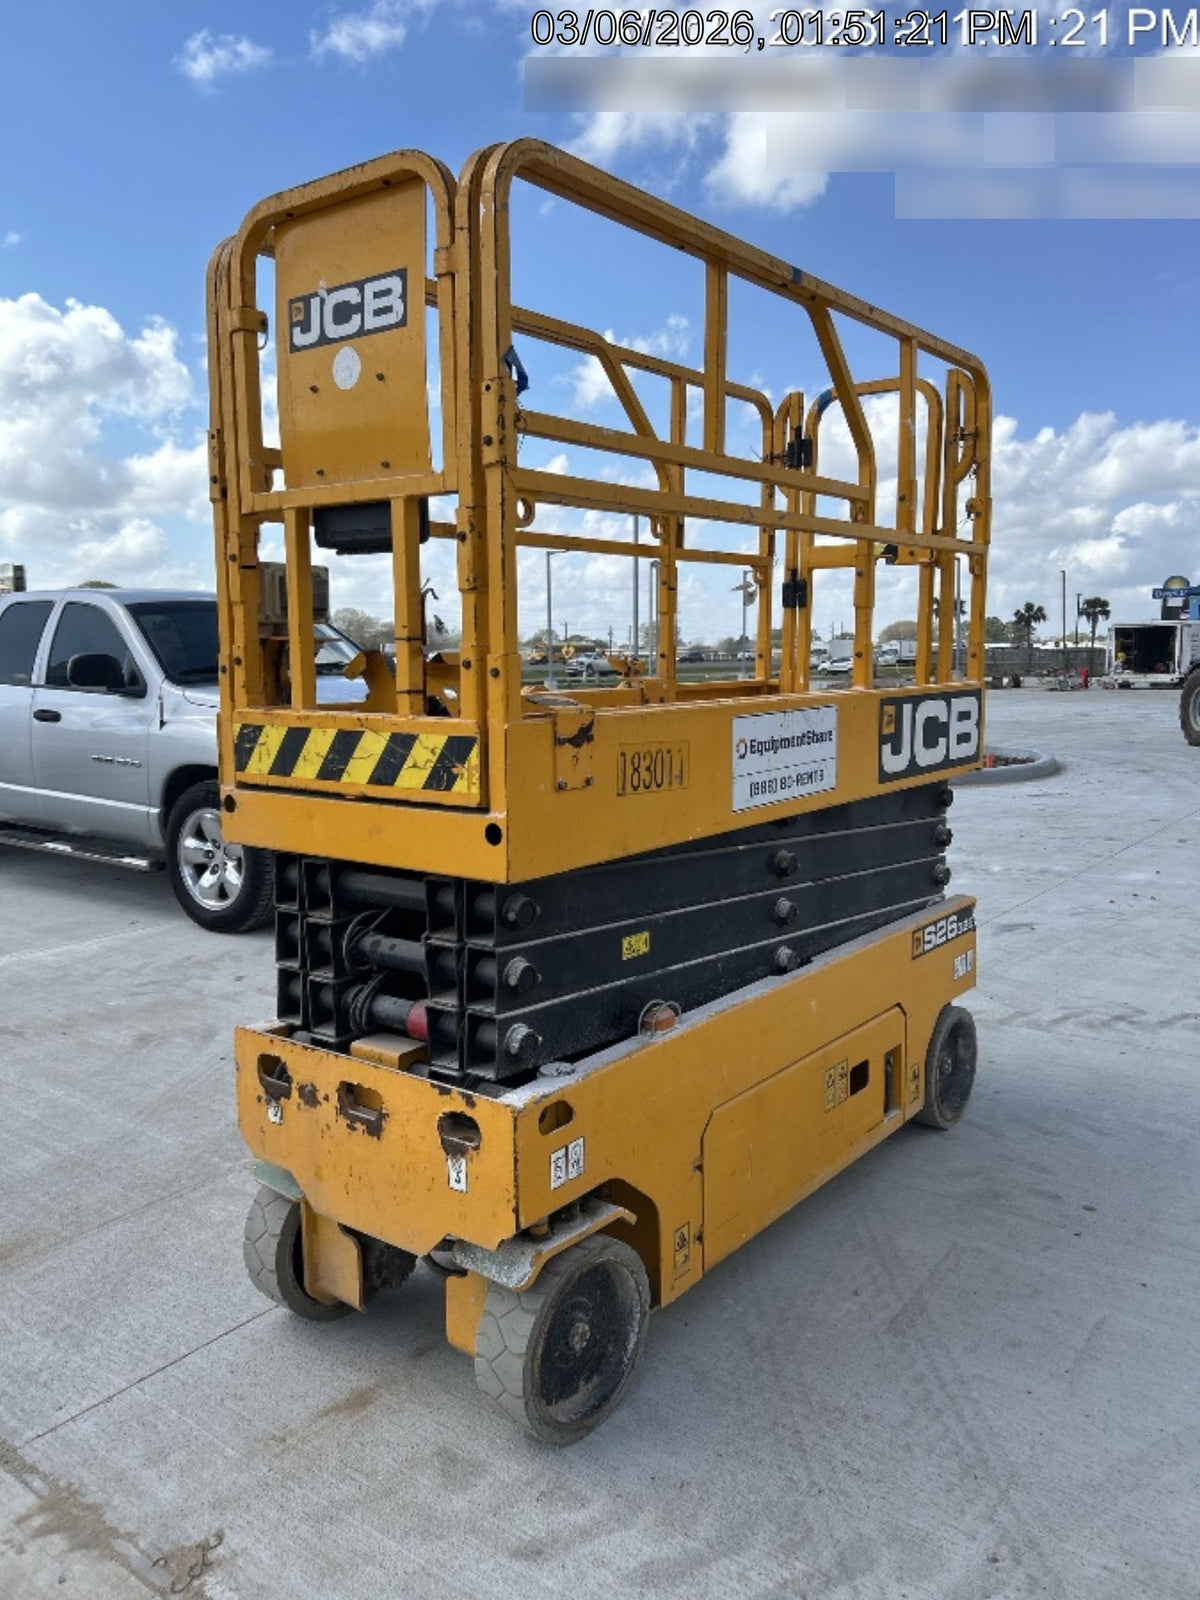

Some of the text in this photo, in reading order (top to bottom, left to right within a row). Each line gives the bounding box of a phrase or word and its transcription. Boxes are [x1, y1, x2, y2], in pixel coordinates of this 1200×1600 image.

[292, 276, 404, 348] JCB
[749, 729, 834, 756] EquipmentShare
[881, 697, 980, 774] JCB
